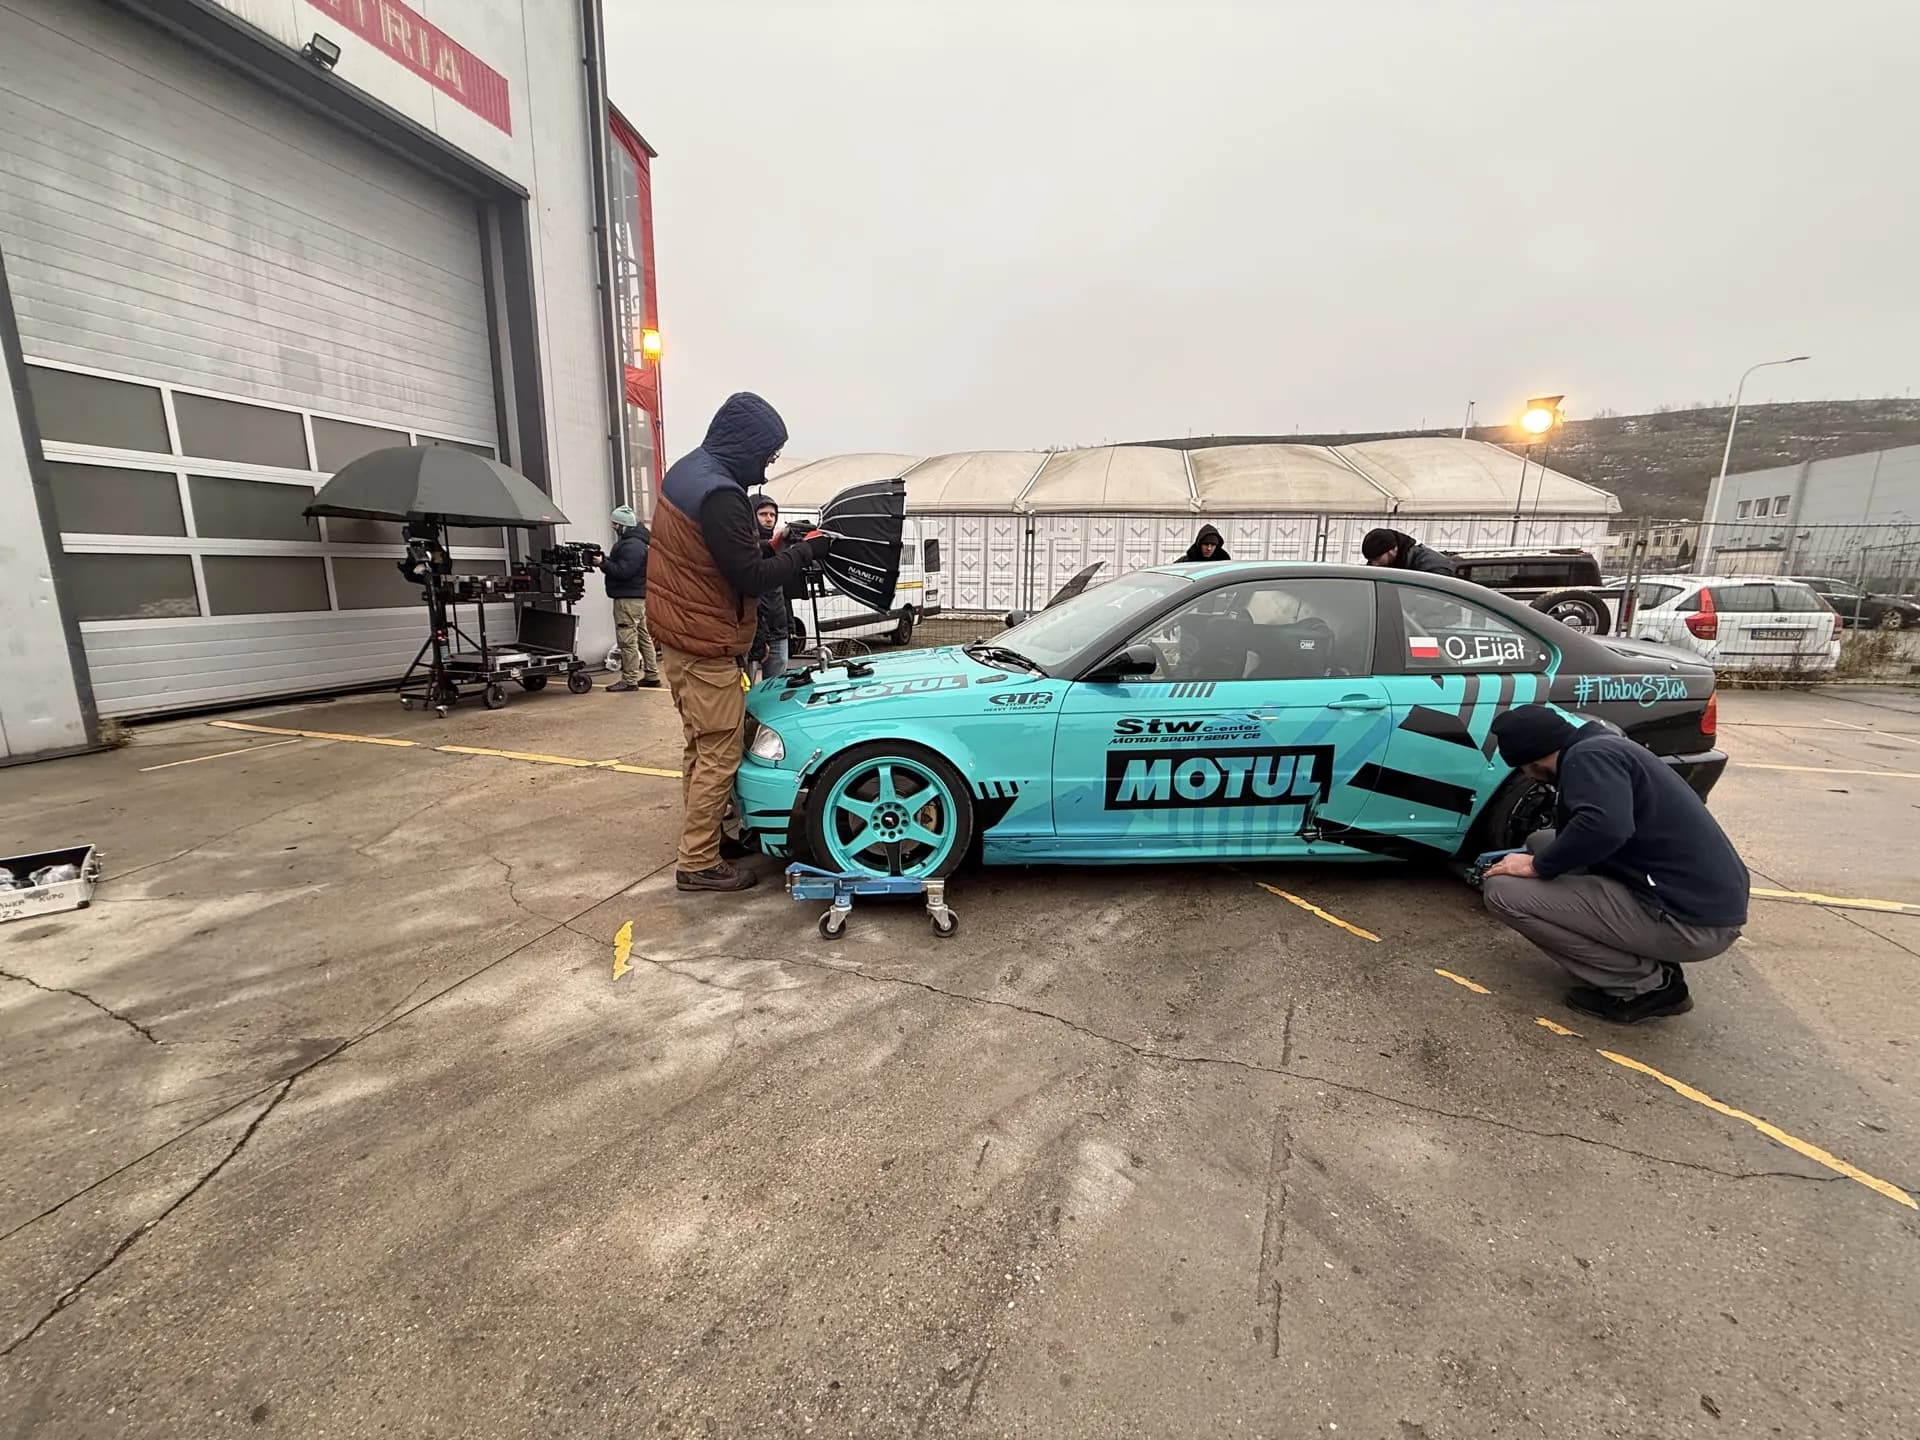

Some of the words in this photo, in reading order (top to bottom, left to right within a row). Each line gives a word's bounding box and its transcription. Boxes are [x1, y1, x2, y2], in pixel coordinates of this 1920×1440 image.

[326, 0, 465, 97] TRIA
[848, 566, 885, 584] NANLITE
[1108, 737, 1157, 746] MOTOR
[1115, 755, 1322, 801] MOTUL
